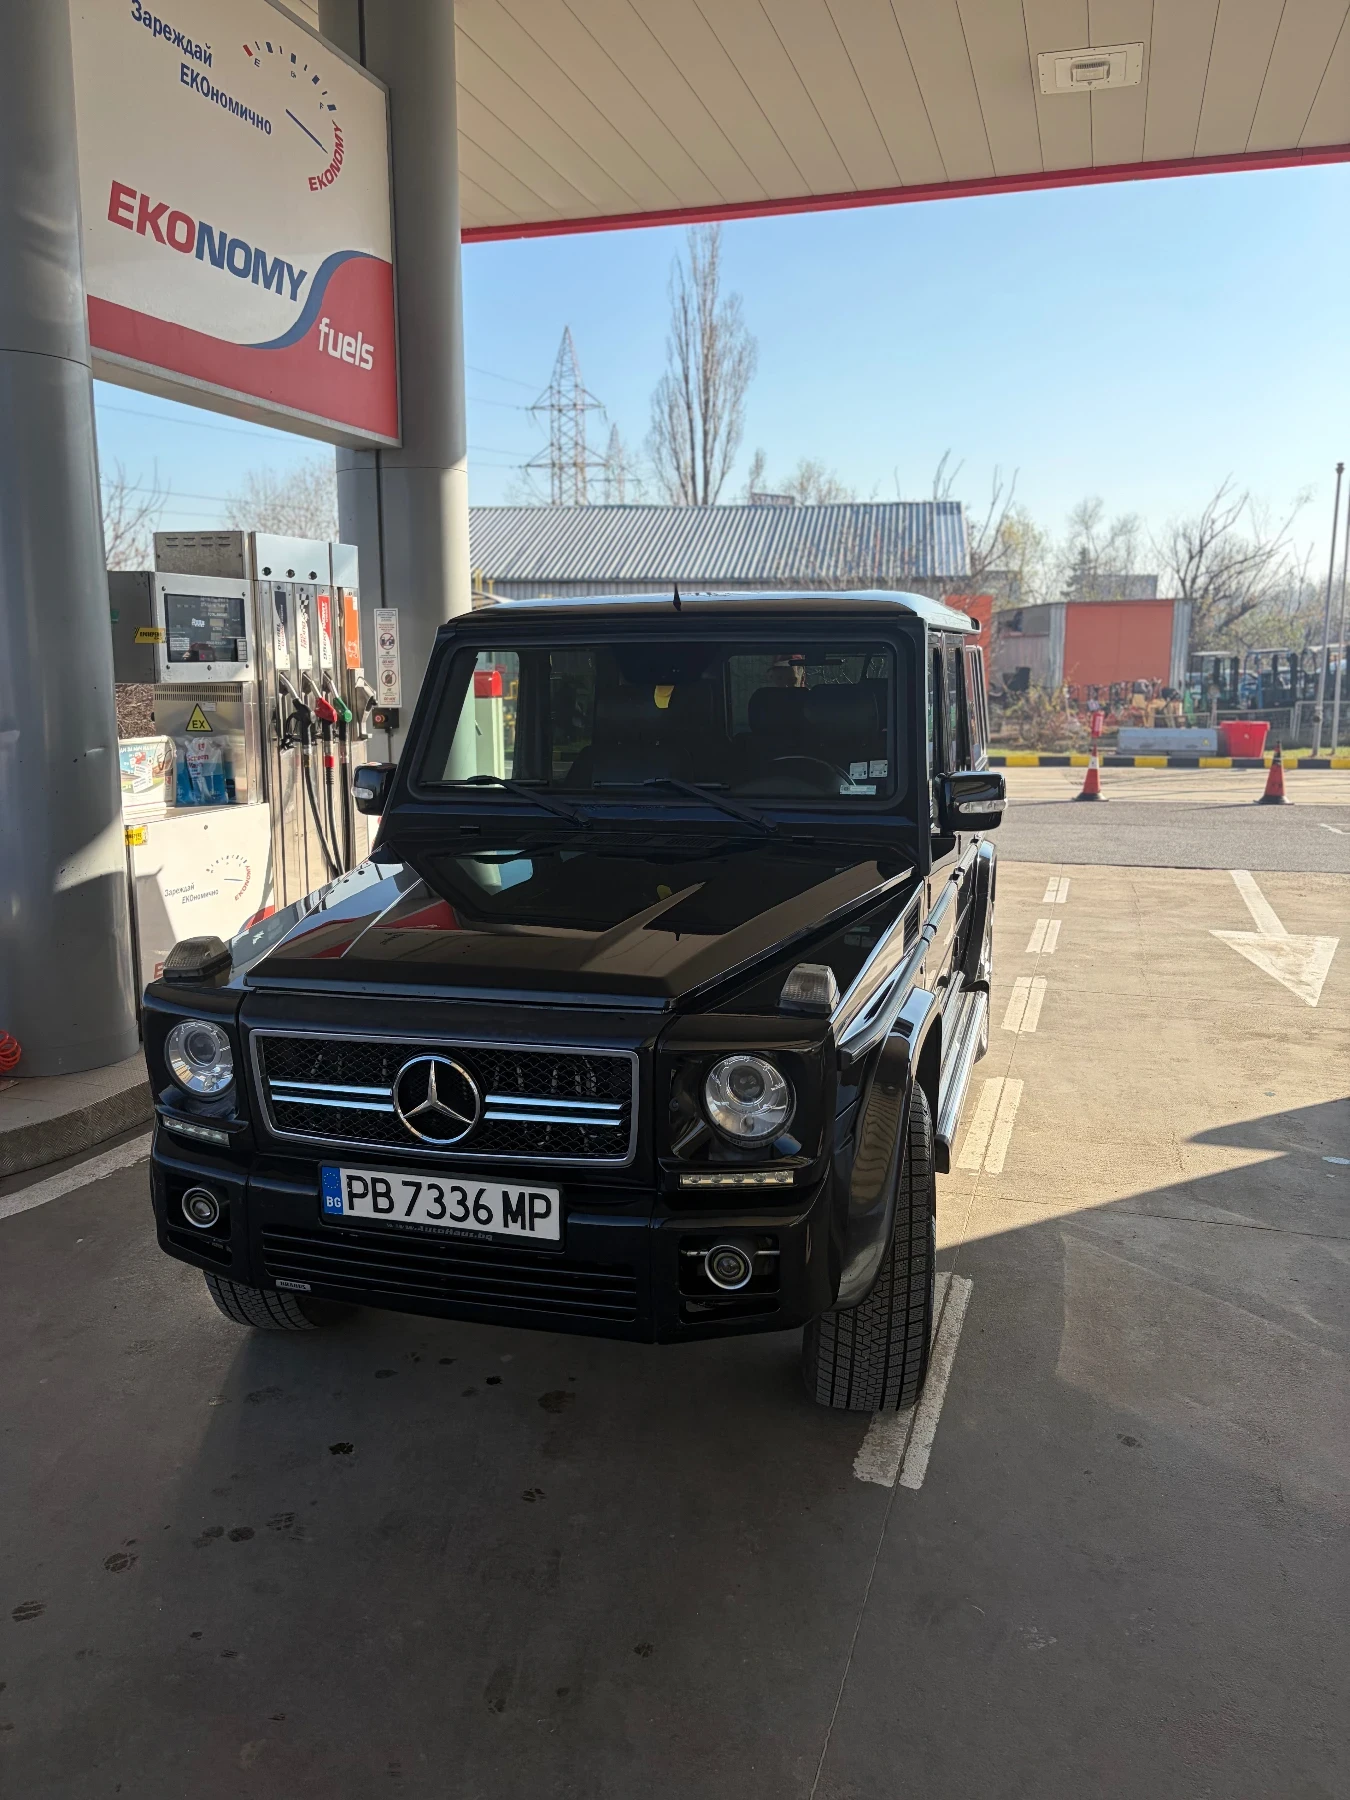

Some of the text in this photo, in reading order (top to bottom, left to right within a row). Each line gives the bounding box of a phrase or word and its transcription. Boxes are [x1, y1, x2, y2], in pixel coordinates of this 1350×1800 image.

[131, 0, 213, 68] Зареждай
[180, 62, 272, 135] ЕКОномично
[308, 119, 344, 192] EKONOMY
[107, 180, 308, 302] EKONOMY
[318, 317, 374, 371] fuels
[192, 720, 206, 729] EX
[326, 1196, 342, 1208] BG
[346, 1174, 552, 1232] PB 7336 MP
